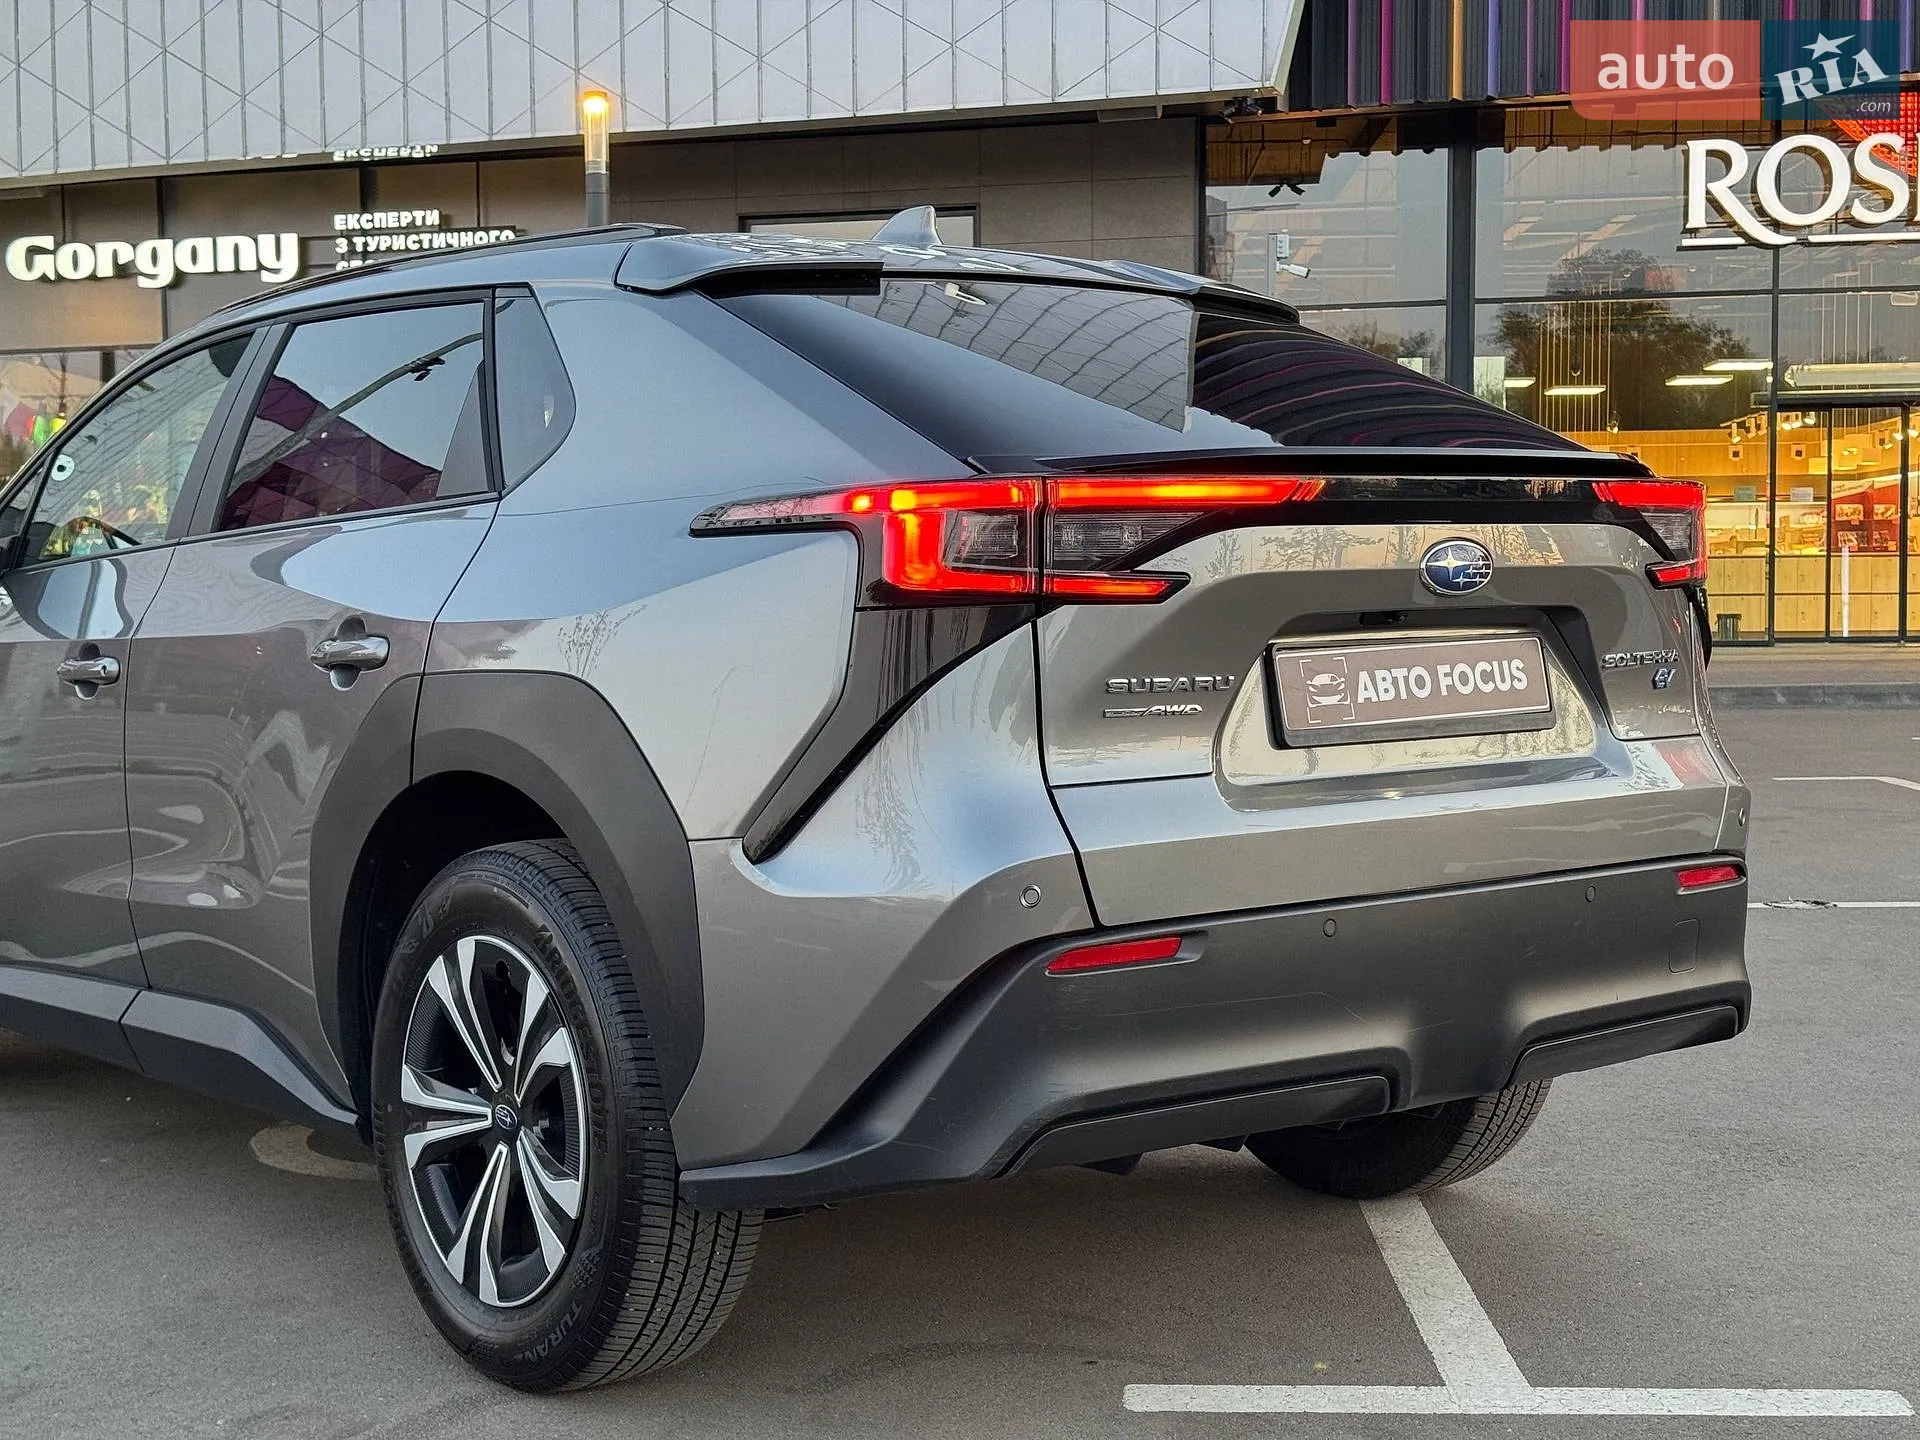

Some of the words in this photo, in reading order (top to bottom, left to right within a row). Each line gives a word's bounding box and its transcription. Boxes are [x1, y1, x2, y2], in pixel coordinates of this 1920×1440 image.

[333, 209, 440, 230] ЕКСПЕРТИ
[352, 229, 516, 252] ТУРИСТИЧНОГО
[5, 233, 299, 288] Gorgany
[1602, 649, 1679, 667] SOLTERRA
[1106, 675, 1235, 693] SUBARU
[1436, 658, 1528, 696] FOCUS
